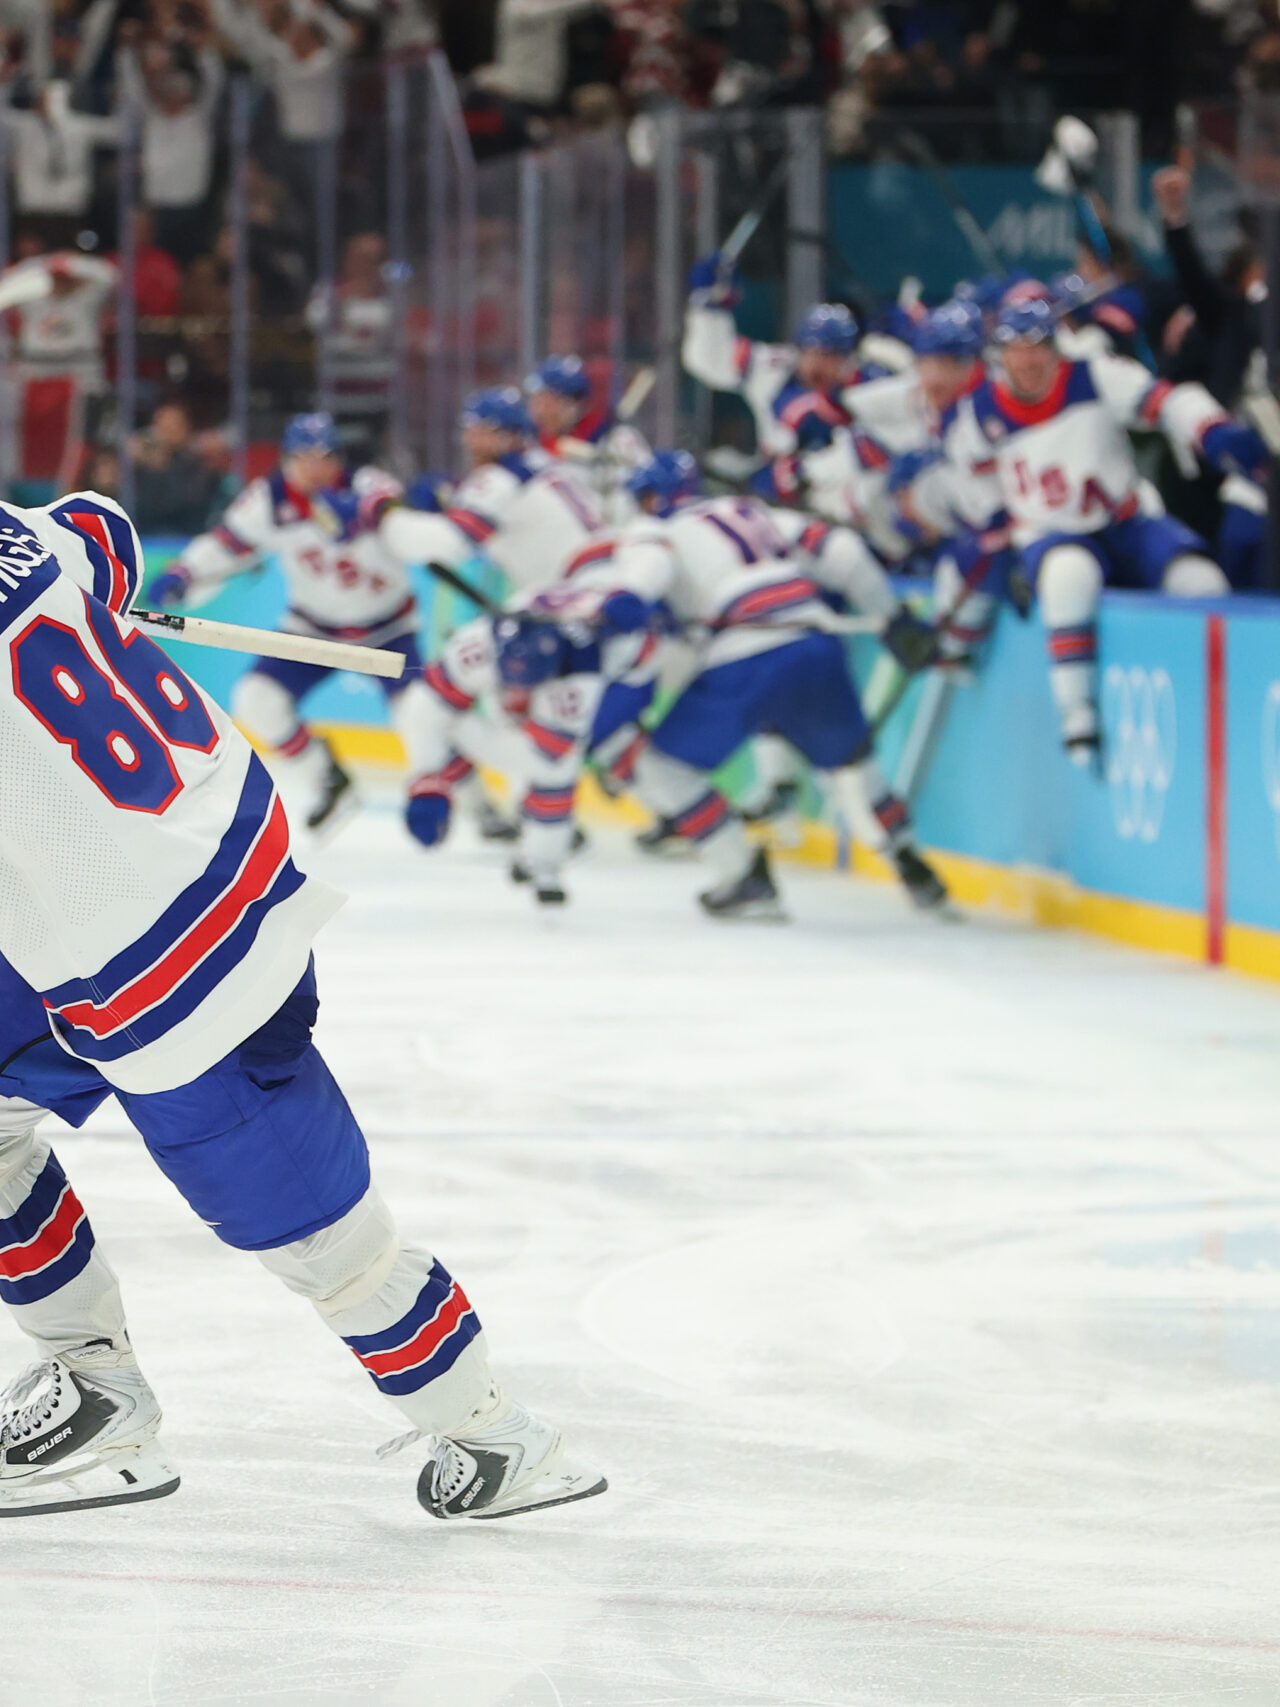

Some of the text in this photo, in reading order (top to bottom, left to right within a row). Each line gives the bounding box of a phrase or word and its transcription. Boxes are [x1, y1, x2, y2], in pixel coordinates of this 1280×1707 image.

[9, 585, 219, 816] 86
[27, 1426, 73, 1462] BAUER
[460, 1476, 487, 1508] BAUER
